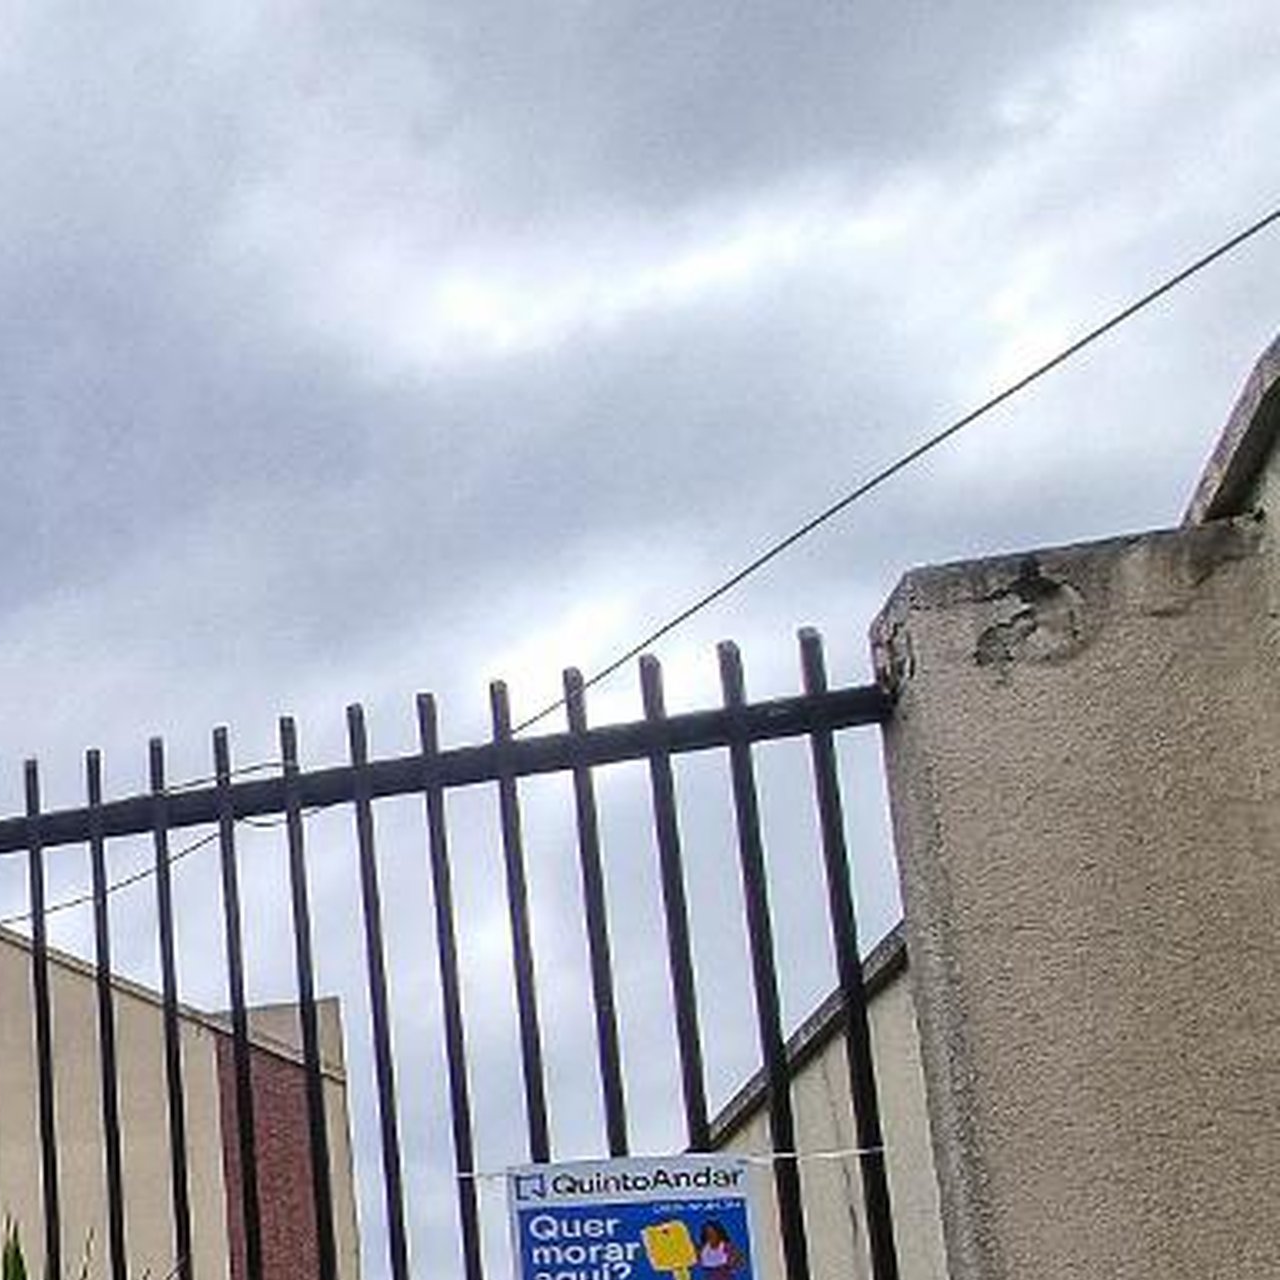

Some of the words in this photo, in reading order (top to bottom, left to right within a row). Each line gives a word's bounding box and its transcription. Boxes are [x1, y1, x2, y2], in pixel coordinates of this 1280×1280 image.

[552, 1167, 744, 1195] QuintoAndar
[530, 1215, 620, 1240] Quer
[533, 1242, 641, 1265] morar
